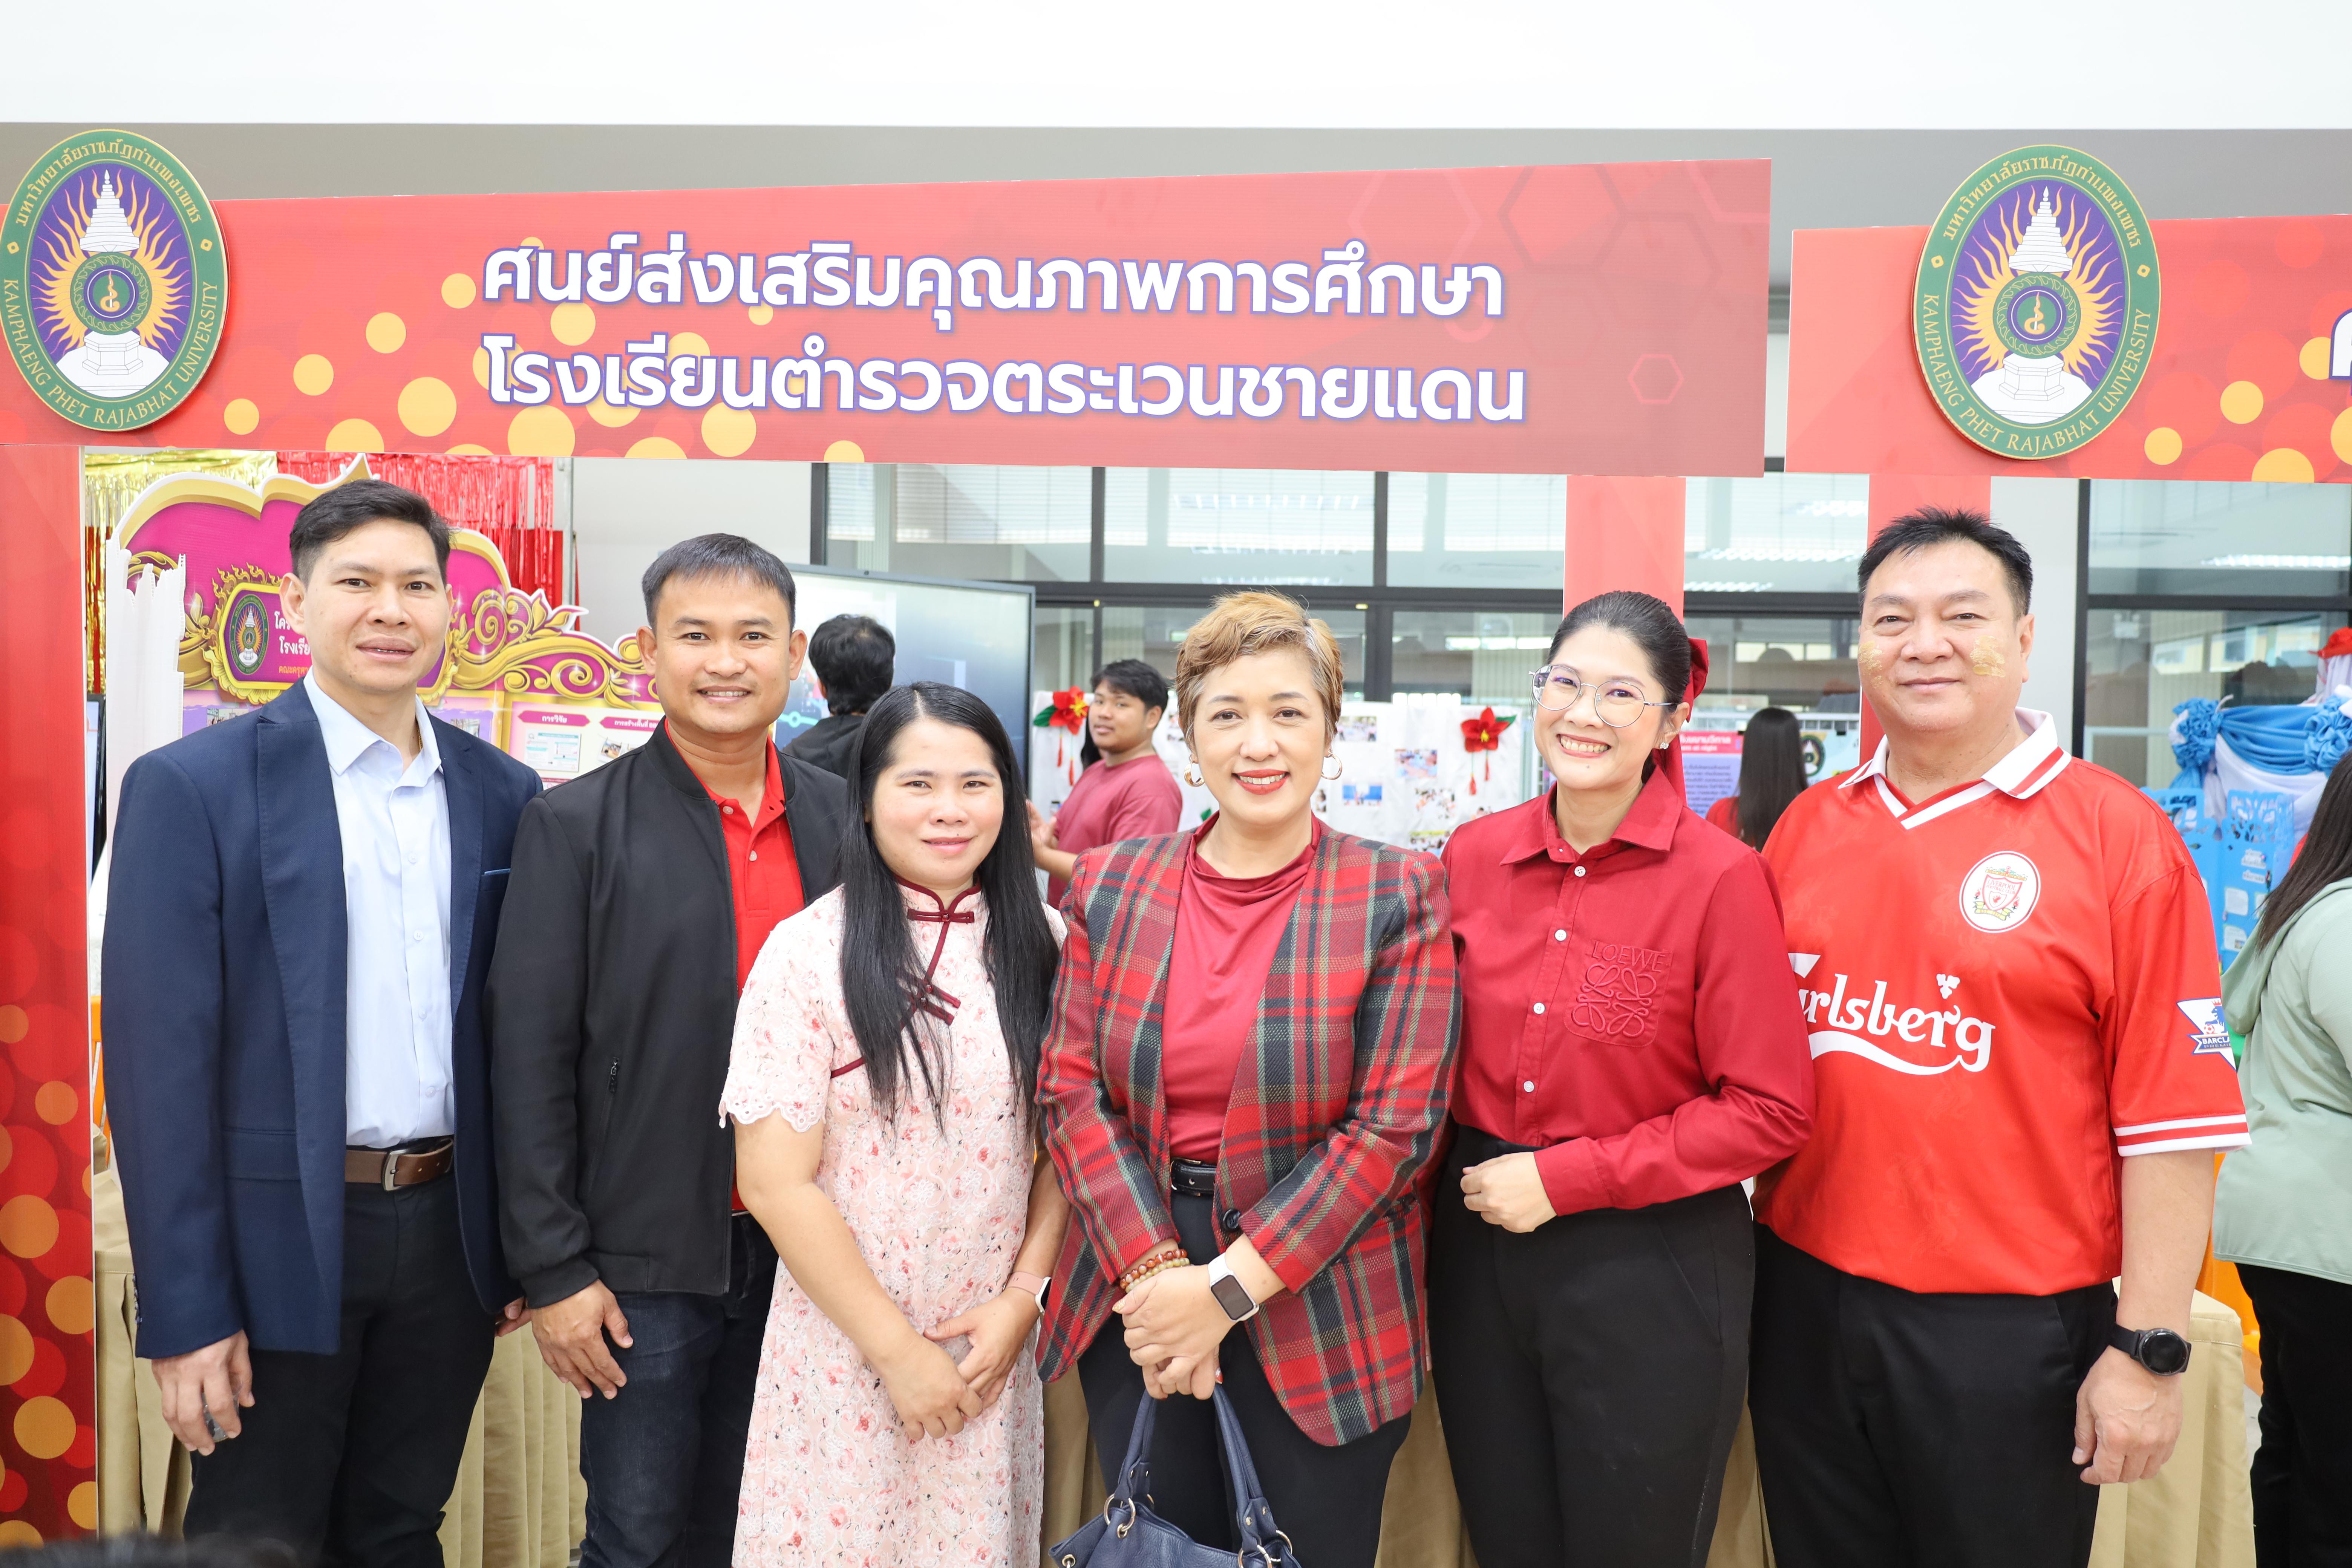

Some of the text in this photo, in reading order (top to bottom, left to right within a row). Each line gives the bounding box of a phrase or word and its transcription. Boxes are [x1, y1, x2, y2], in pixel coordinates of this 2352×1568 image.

[16, 138, 202, 227] มหาวิทยาลัยราชภัฏกำแพงเพชร
[1943, 155, 2141, 248] มหาวิทยาลัยราชภัฏกำแพงเพชร
[4, 278, 218, 428] KAMPHAENG PHET RAJABHAT UNIVERSITY
[481, 332, 1527, 423] โรงเรียนตำรวจตระเวนชายแดน
[1924, 293, 2151, 456] KAMPHAENG PHET RAJABHAT UNIVERSITY
[1987, 879, 2016, 891] LIVERPOOL
[1591, 941, 1666, 972] LOEWE
